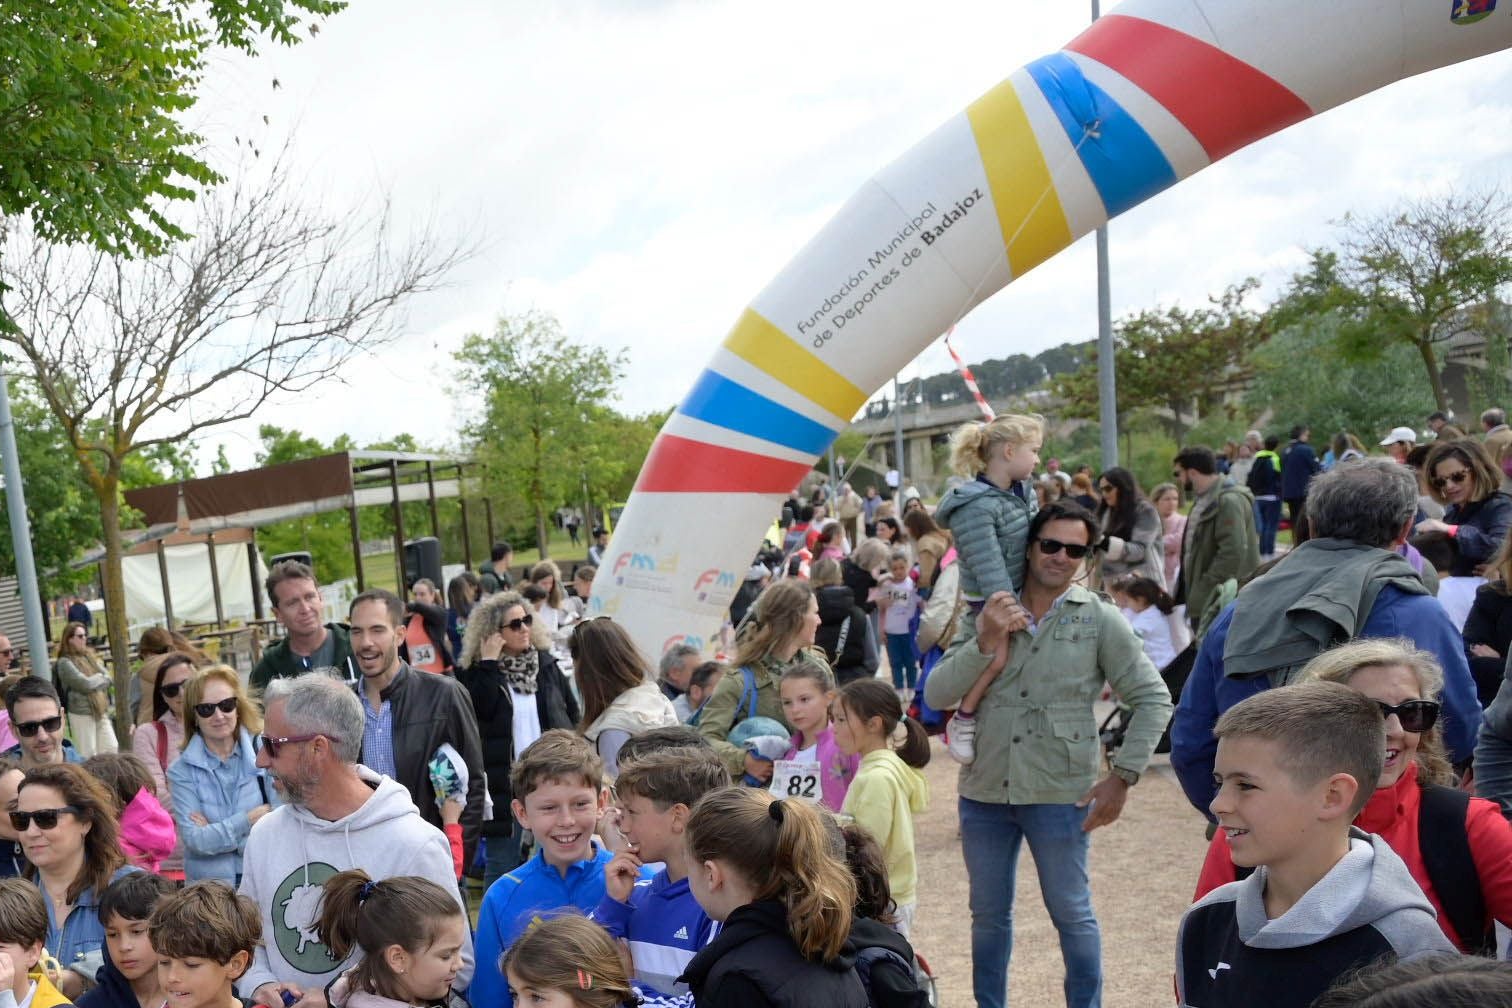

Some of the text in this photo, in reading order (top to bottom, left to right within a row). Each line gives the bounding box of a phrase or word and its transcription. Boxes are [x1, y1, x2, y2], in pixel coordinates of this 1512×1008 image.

[797, 201, 938, 334] Fundación Municipal
[812, 187, 984, 349] de Deportes de Badajoz
[416, 649, 431, 662] 34
[787, 775, 816, 797] 82
